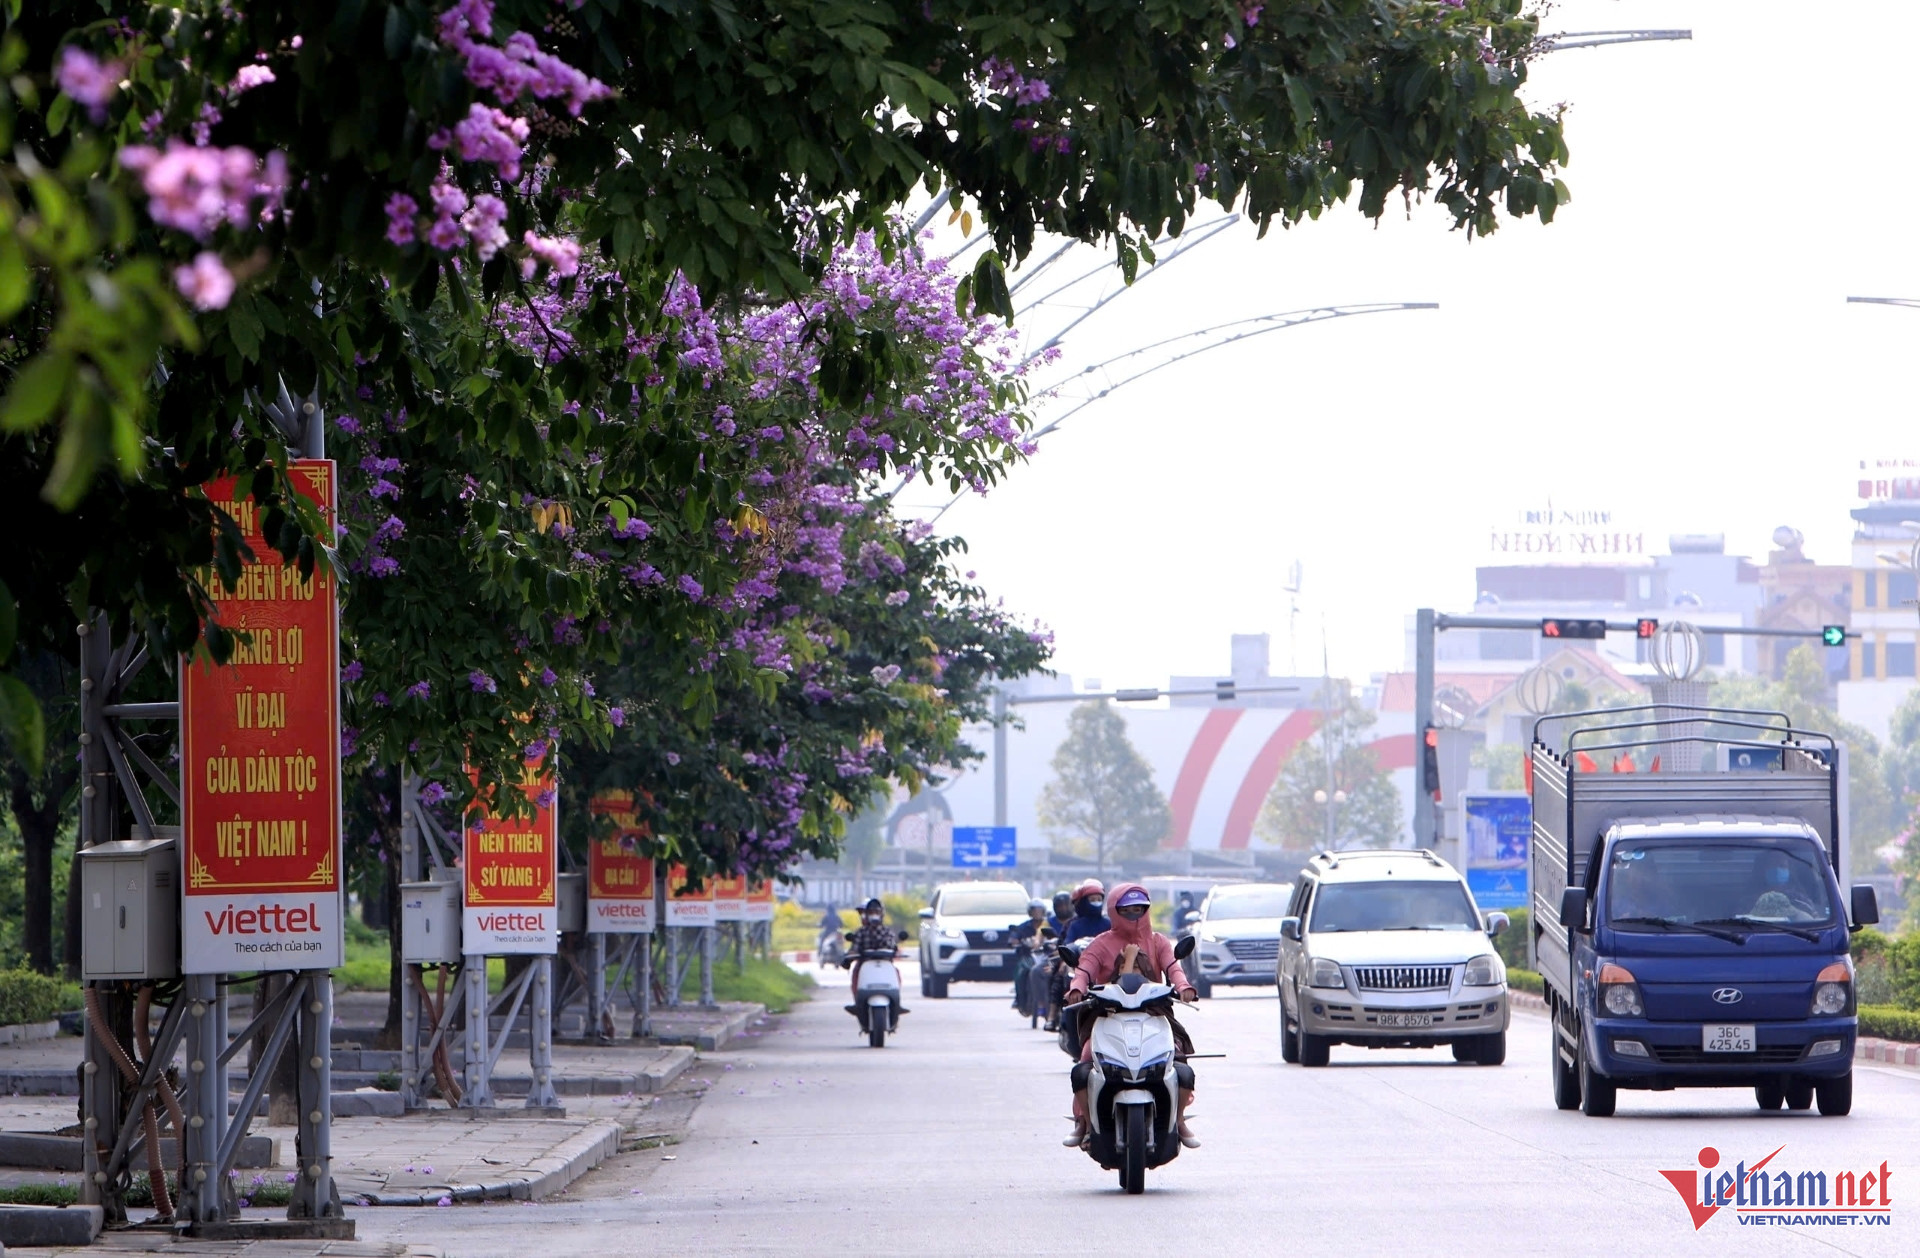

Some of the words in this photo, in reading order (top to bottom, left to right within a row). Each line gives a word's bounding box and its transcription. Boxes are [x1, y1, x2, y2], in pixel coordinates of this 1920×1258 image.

[277, 625, 303, 672] LỢI
[236, 685, 252, 728] VĨ
[257, 693, 286, 736] ĐẠI
[207, 745, 241, 794] CỦA
[246, 749, 281, 792] DÂN
[285, 748, 317, 800] TỘC
[216, 814, 252, 866] VIỆT
[257, 820, 296, 856] NAM
[479, 830, 504, 853] NÊN
[508, 830, 543, 853] THIÊN
[500, 863, 533, 887] VÀNG
[204, 903, 321, 935] viettel
[597, 903, 647, 917] viettel
[478, 912, 545, 932] viettel
[235, 942, 258, 953] Theo
[260, 942, 282, 953] cách
[284, 940, 302, 951] của
[304, 941, 321, 952] bạn
[1718, 1027, 1741, 1038] 36C
[1709, 1039, 1750, 1050] 425.45
